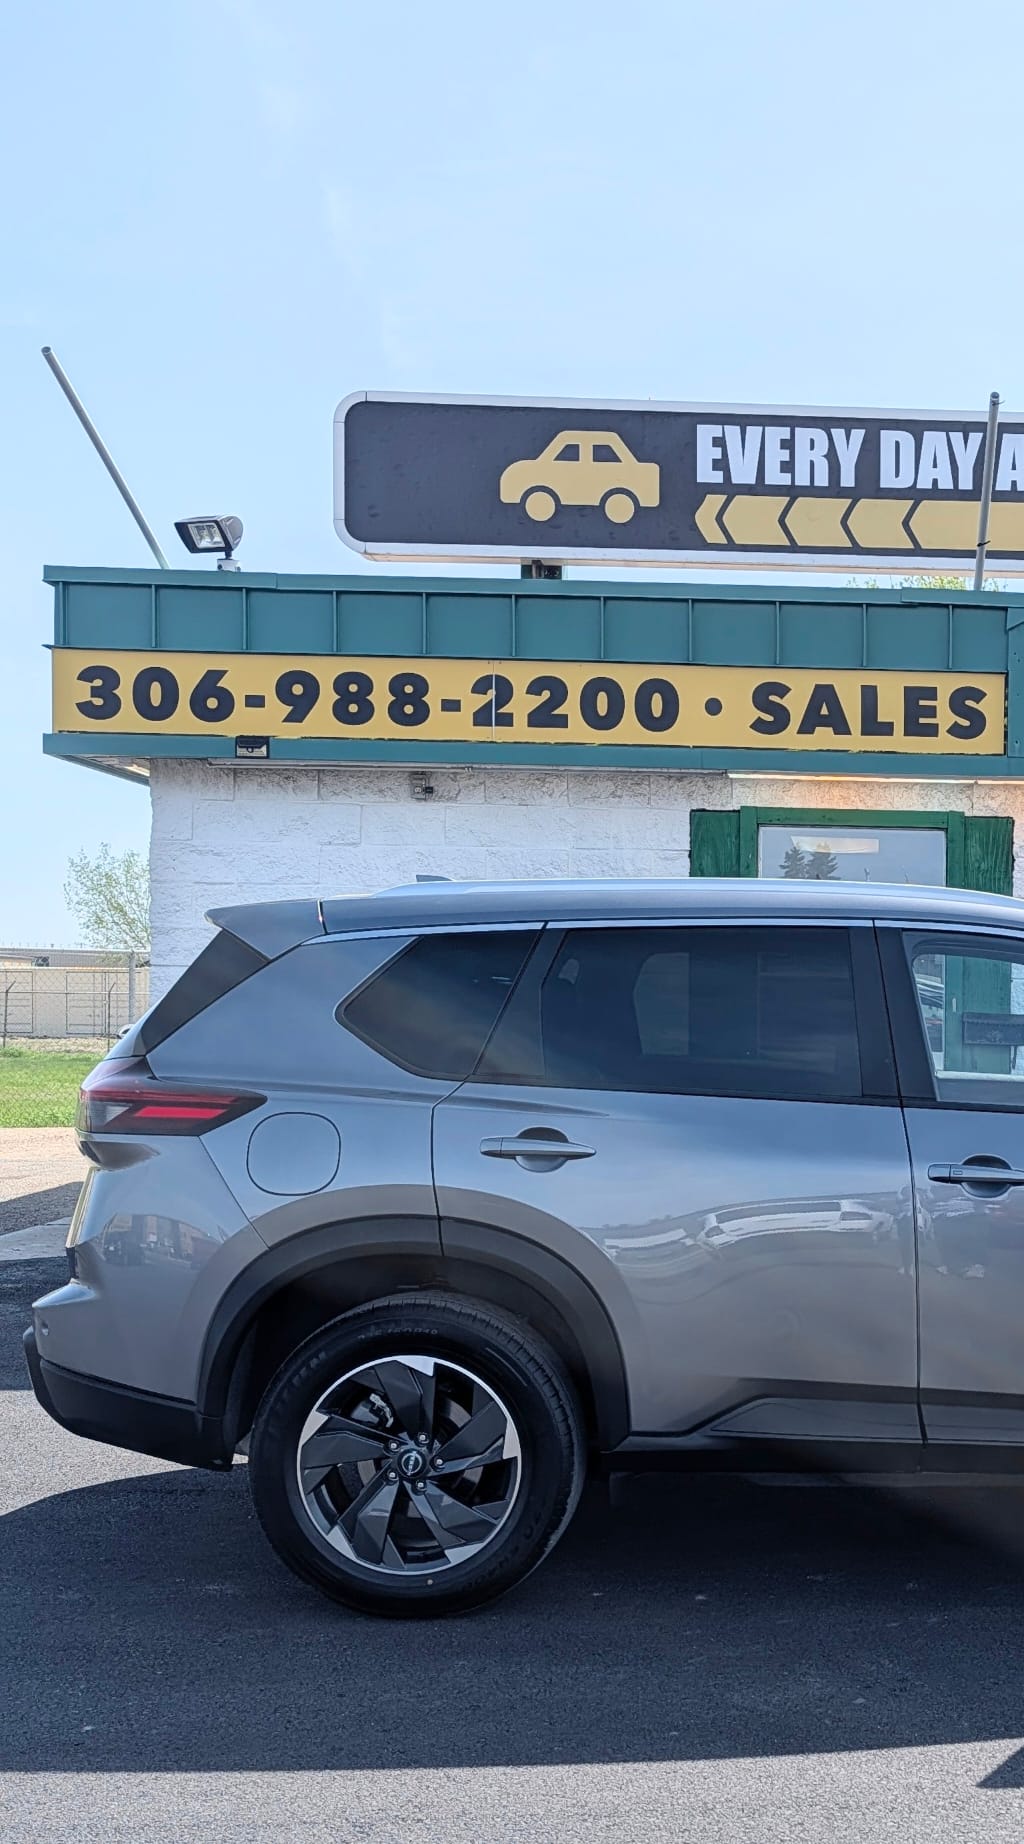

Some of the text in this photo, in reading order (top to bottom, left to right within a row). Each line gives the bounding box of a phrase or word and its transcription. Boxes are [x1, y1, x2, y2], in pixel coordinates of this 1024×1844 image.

[695, 423, 867, 490] EVERY
[878, 428, 986, 491] DAY
[75, 664, 989, 741] 306-988-2200 SALES
